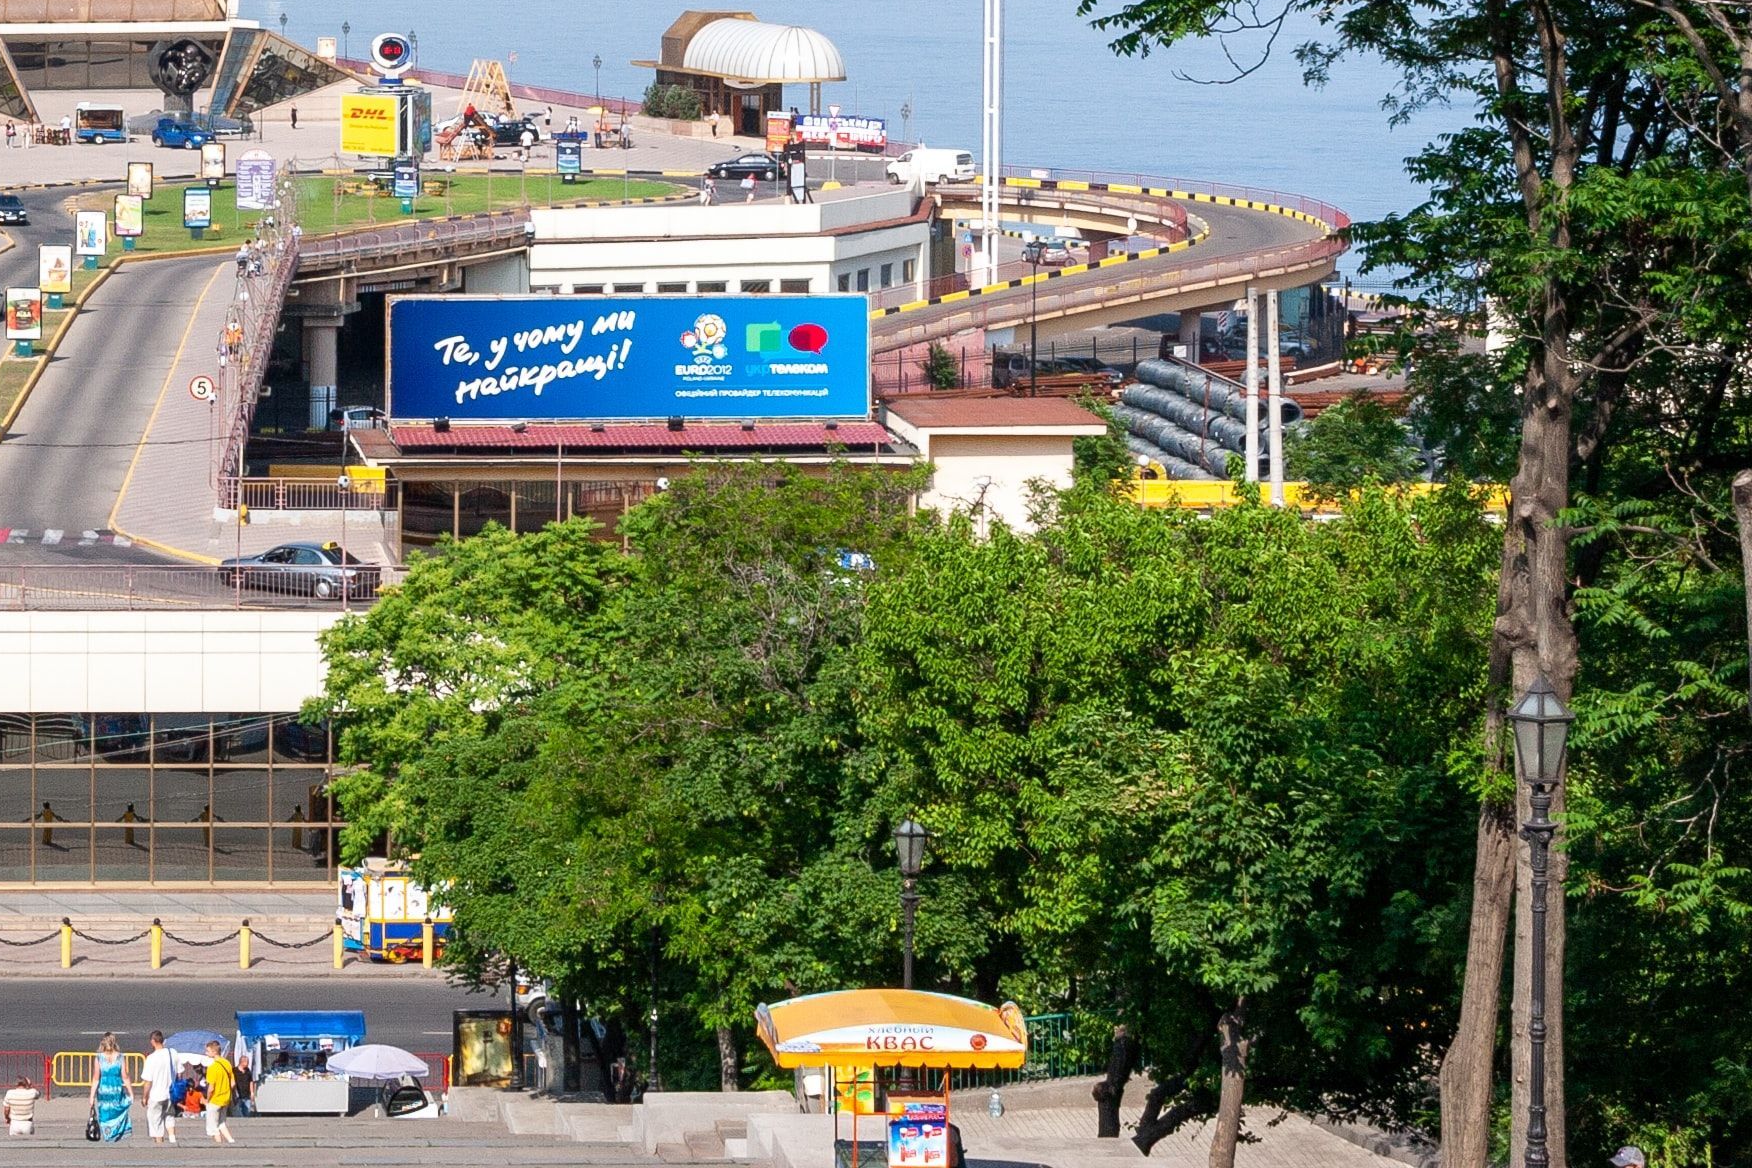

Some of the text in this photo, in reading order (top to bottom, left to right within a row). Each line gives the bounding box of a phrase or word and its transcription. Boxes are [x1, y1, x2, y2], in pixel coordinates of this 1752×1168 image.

[350, 108, 387, 120] DHL
[434, 310, 636, 371] Те, у чому ми
[455, 338, 633, 404] найкращі!
[197, 381, 207, 395] 5
[866, 1035, 935, 1050] КВАС
